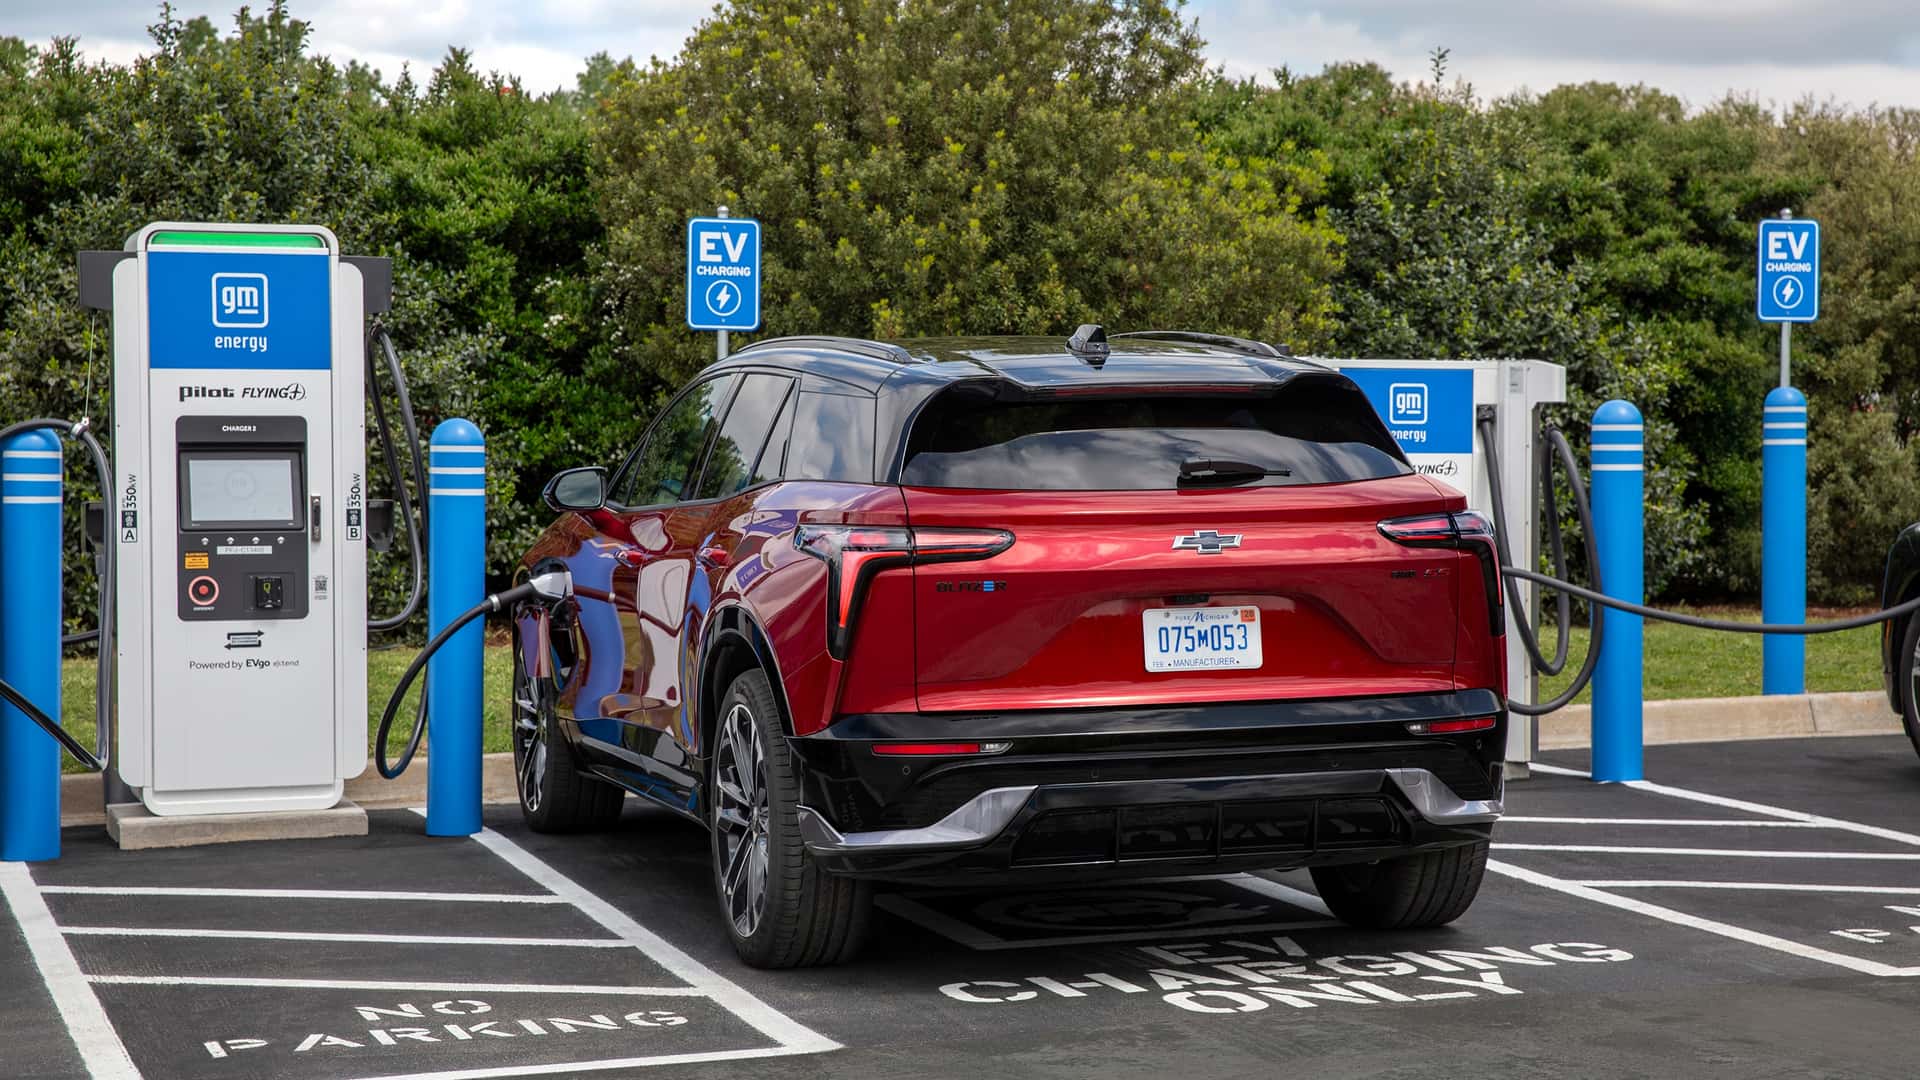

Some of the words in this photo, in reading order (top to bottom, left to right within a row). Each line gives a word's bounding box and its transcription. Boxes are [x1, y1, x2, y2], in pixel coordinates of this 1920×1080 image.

[700, 231, 748, 263] EV
[1768, 231, 1809, 260] EV
[696, 265, 751, 277] CHARGING
[1766, 262, 1812, 273] CHARGING
[222, 286, 259, 315] gm
[214, 335, 268, 352] energy
[241, 387, 288, 399] FLYING
[1396, 393, 1422, 415] gm
[125, 529, 135, 541] A
[350, 527, 358, 538] B
[1158, 624, 1248, 653] 075M053
[189, 660, 231, 669] Powered
[231, 660, 243, 670] by
[246, 658, 271, 669] EVgo
[1173, 657, 1236, 667] MANUFACTURER
[1137, 936, 1308, 965] EV
[938, 942, 1634, 1003] CHARGING
[1163, 972, 1525, 1014] ONLY
[354, 1000, 492, 1021] NO
[203, 1011, 689, 1058] PARKING
